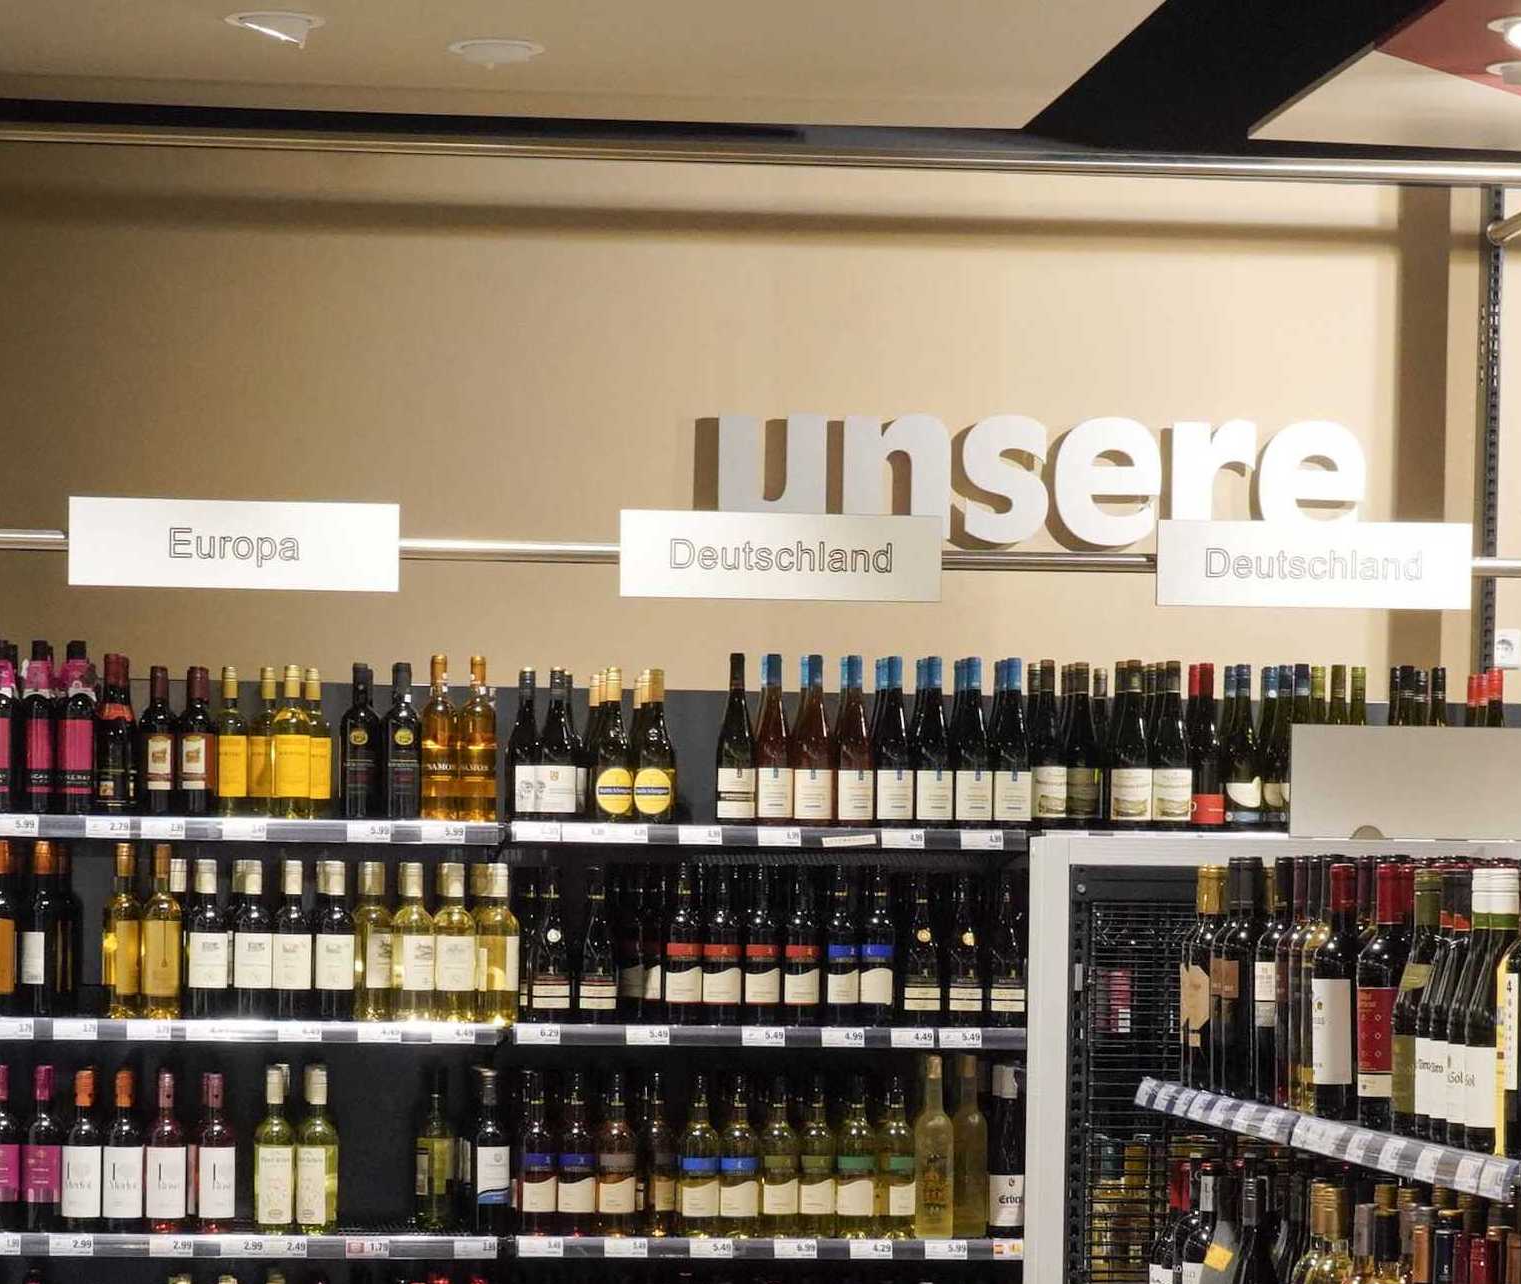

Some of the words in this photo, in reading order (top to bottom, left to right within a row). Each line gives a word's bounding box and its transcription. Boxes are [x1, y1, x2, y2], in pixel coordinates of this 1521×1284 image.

[718, 413, 1366, 548] unsere
[168, 528, 301, 568] Europa
[669, 538, 894, 574] Deutschland
[1204, 547, 1423, 583] Deutschland
[15, 820, 35, 830] 5.99
[649, 1029, 668, 1039] 5.49
[765, 1031, 784, 1041] 5.49
[844, 1031, 864, 1042] 4.99
[914, 1031, 933, 1041] 4.49
[962, 1031, 981, 1042] 5.49
[72, 1239, 92, 1249] 2.99
[173, 1240, 193, 1250] 2.99
[243, 1240, 263, 1251] 2.99
[287, 1241, 307, 1251] 2.49
[712, 1242, 732, 1252] 5.49
[872, 1243, 892, 1253] 4.29
[948, 1243, 967, 1253] 5.99
